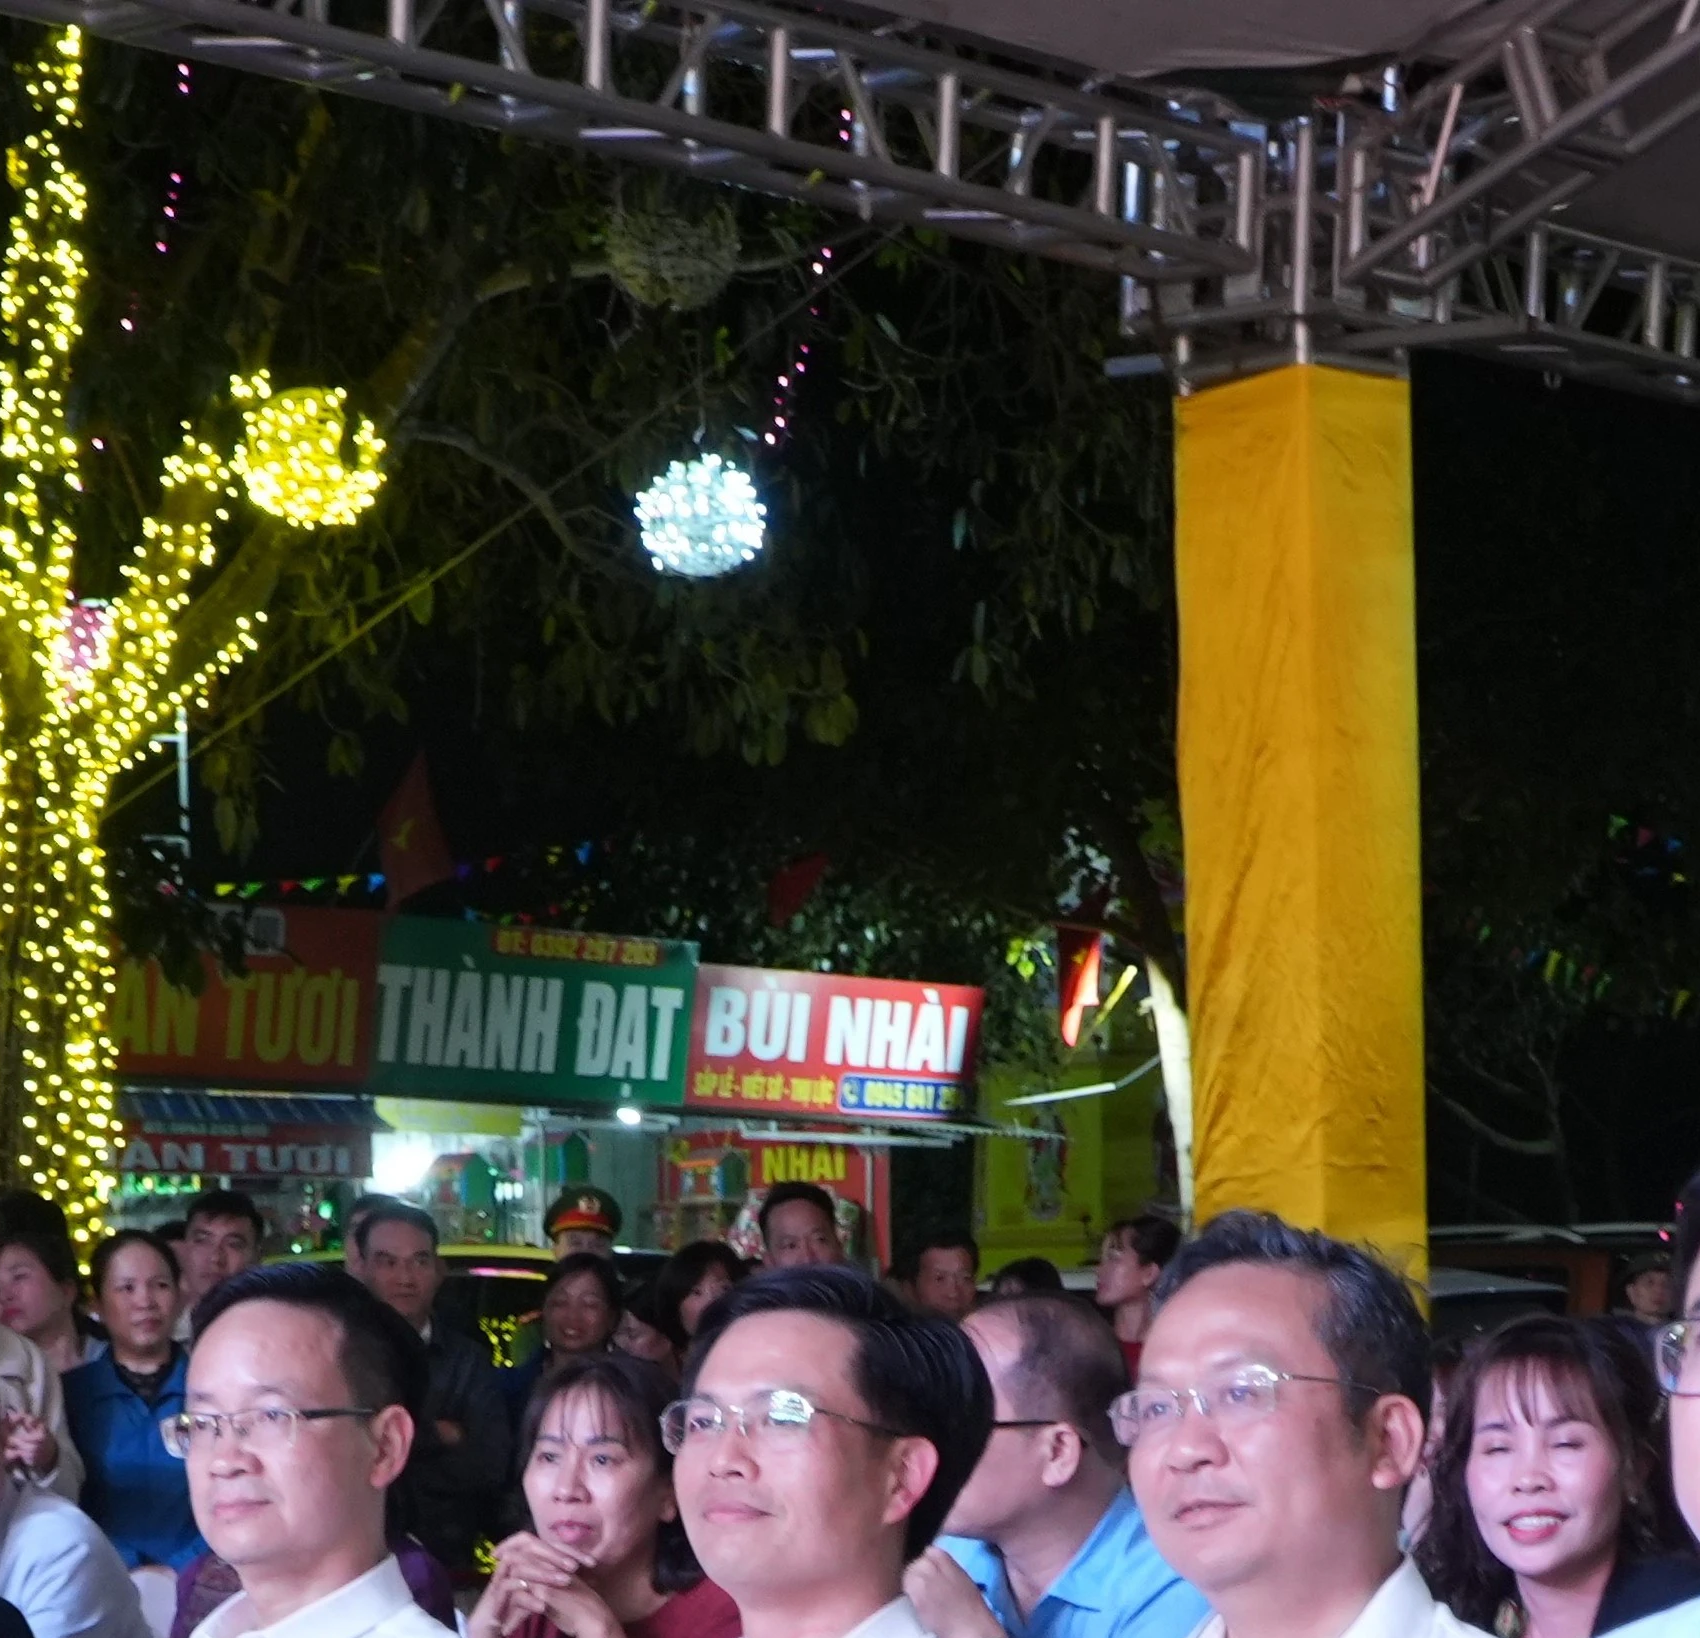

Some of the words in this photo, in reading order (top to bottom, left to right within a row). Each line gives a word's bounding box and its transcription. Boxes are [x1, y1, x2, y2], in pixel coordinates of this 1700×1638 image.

[219, 966, 360, 1067] TƯƠI
[377, 953, 564, 1074] THÀNH
[574, 980, 684, 1098] ĐẠT
[704, 976, 812, 1063] BÙI
[824, 988, 969, 1074] NHÀI
